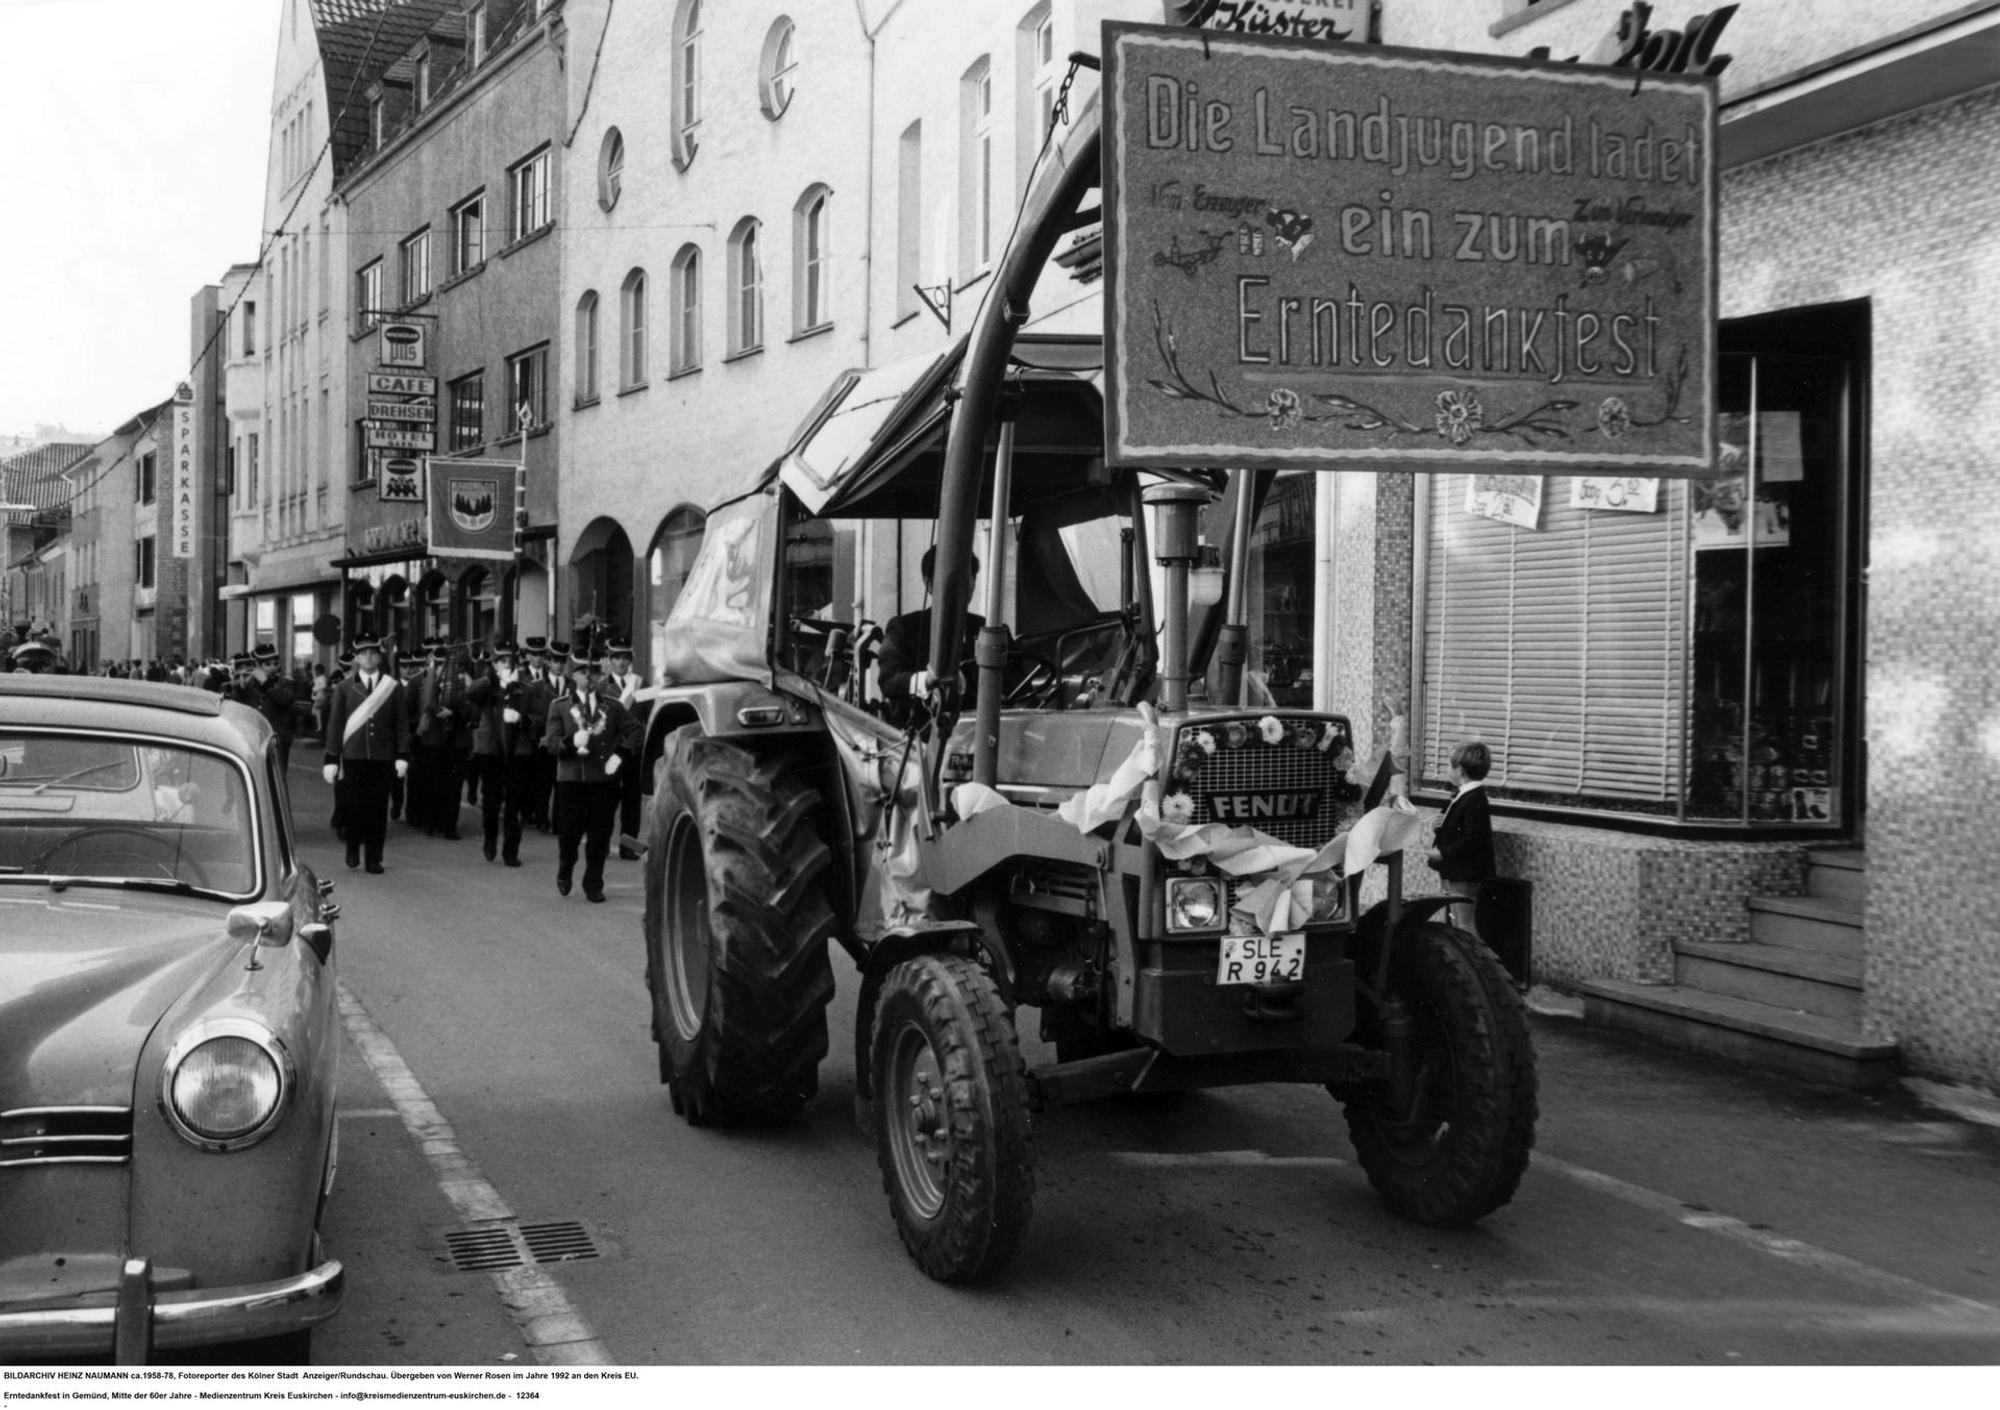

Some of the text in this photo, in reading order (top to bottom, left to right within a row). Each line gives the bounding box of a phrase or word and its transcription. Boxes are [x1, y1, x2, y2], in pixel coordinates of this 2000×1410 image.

[1147, 74, 1699, 186] Die Landjugend ladet
[1340, 190, 1432, 260] ein
[1453, 210, 1571, 266] zum
[1237, 275, 1660, 383] Erntedankfest
[371, 404, 433, 419] DREHSEN
[375, 430, 429, 443] HOTEL
[180, 411, 191, 553] SPARKASSE
[1213, 792, 1320, 819] FENDT
[1242, 938, 1283, 960] SLE
[1226, 958, 1300, 982] R 942
